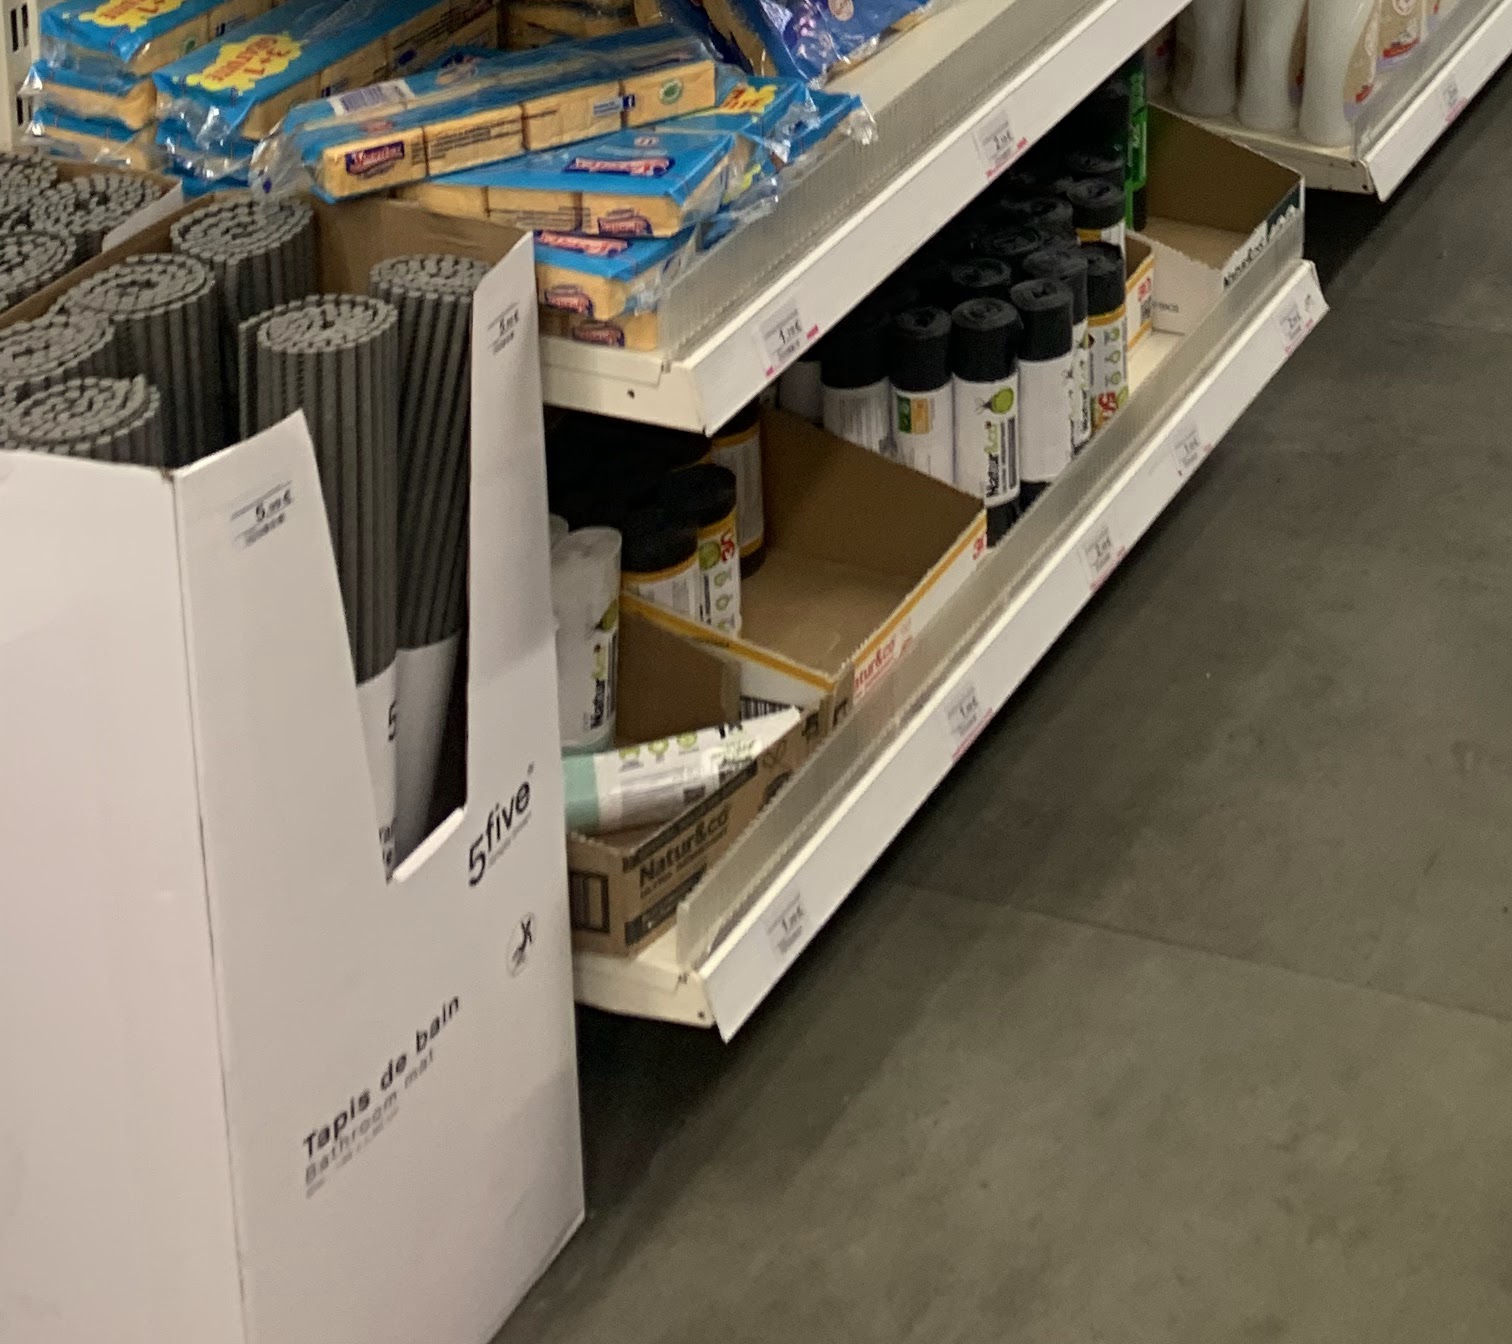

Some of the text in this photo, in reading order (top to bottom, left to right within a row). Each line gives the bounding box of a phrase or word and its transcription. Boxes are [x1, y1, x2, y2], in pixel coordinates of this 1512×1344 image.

[853, 639, 895, 691] atur&co
[639, 810, 729, 887] Natur&co
[302, 1088, 371, 1159] Tapis
[380, 1053, 407, 1091] de
[415, 995, 459, 1055] bain
[305, 1090, 398, 1186] Bathroom
[404, 1046, 434, 1090] mat
